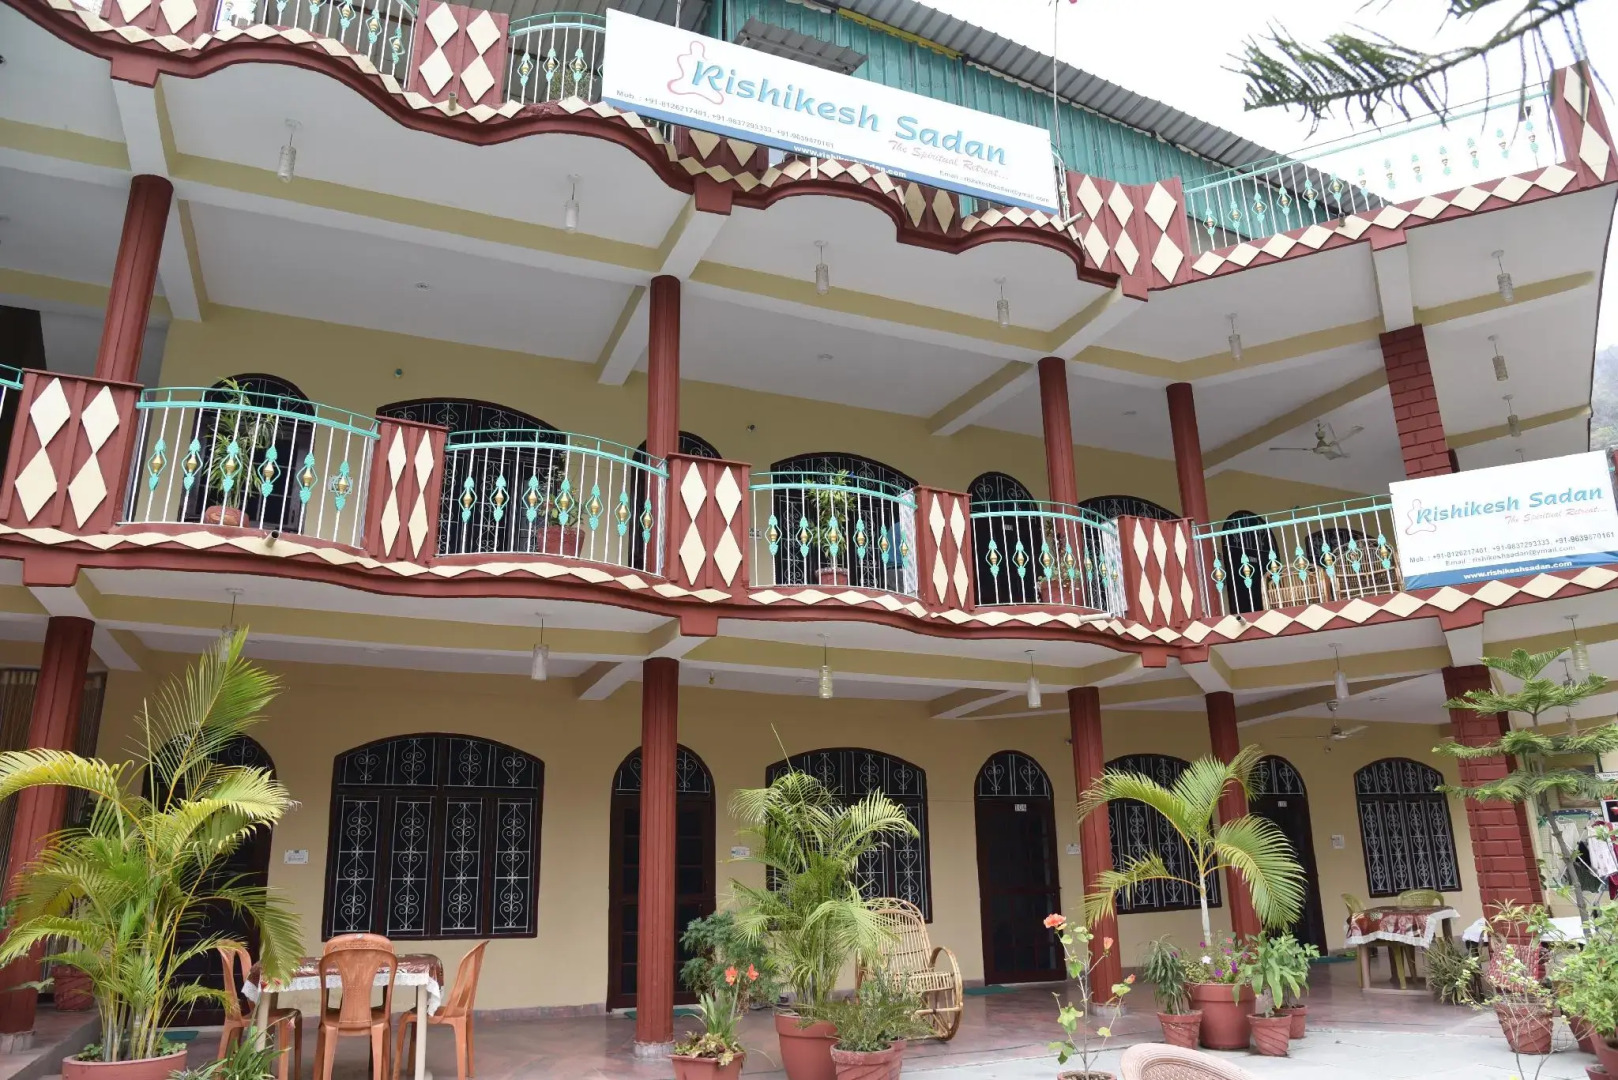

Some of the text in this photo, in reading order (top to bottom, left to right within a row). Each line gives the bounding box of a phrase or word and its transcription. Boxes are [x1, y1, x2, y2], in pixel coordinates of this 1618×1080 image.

[691, 61, 1007, 166] Rishikesh Sadan
[888, 139, 908, 154] The
[912, 146, 959, 167] Spiritual
[1416, 487, 1603, 525] Rishikesh Sadan
[1504, 515, 1519, 526] The
[1523, 511, 1562, 523] Spiritual
[1463, 561, 1573, 580] www.rishikeshsadan.com
